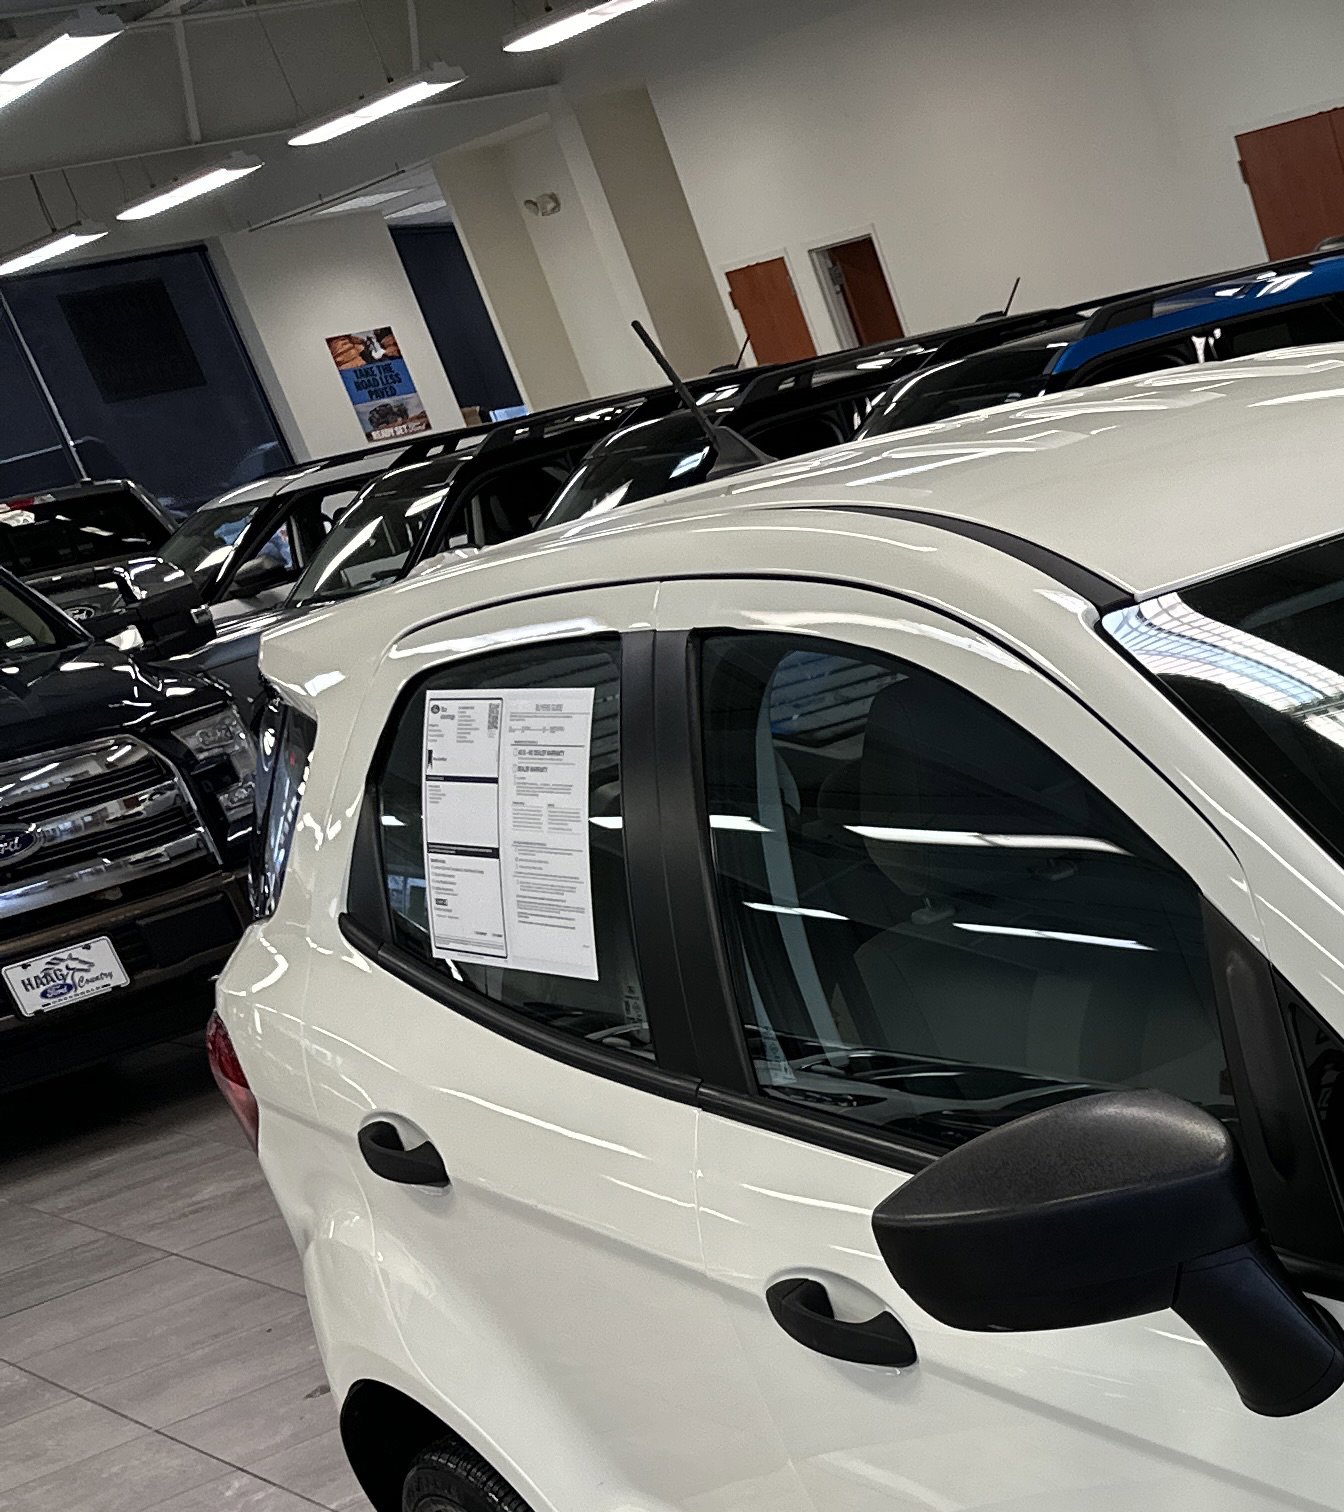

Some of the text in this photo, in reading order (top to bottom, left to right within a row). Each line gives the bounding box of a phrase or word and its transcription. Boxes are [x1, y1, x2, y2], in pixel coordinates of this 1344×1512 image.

[354, 363, 394, 378] TAKE THE
[354, 373, 402, 391] ROAD LESS
[368, 387, 397, 400] PAVED
[21, 968, 65, 993] HAAG
